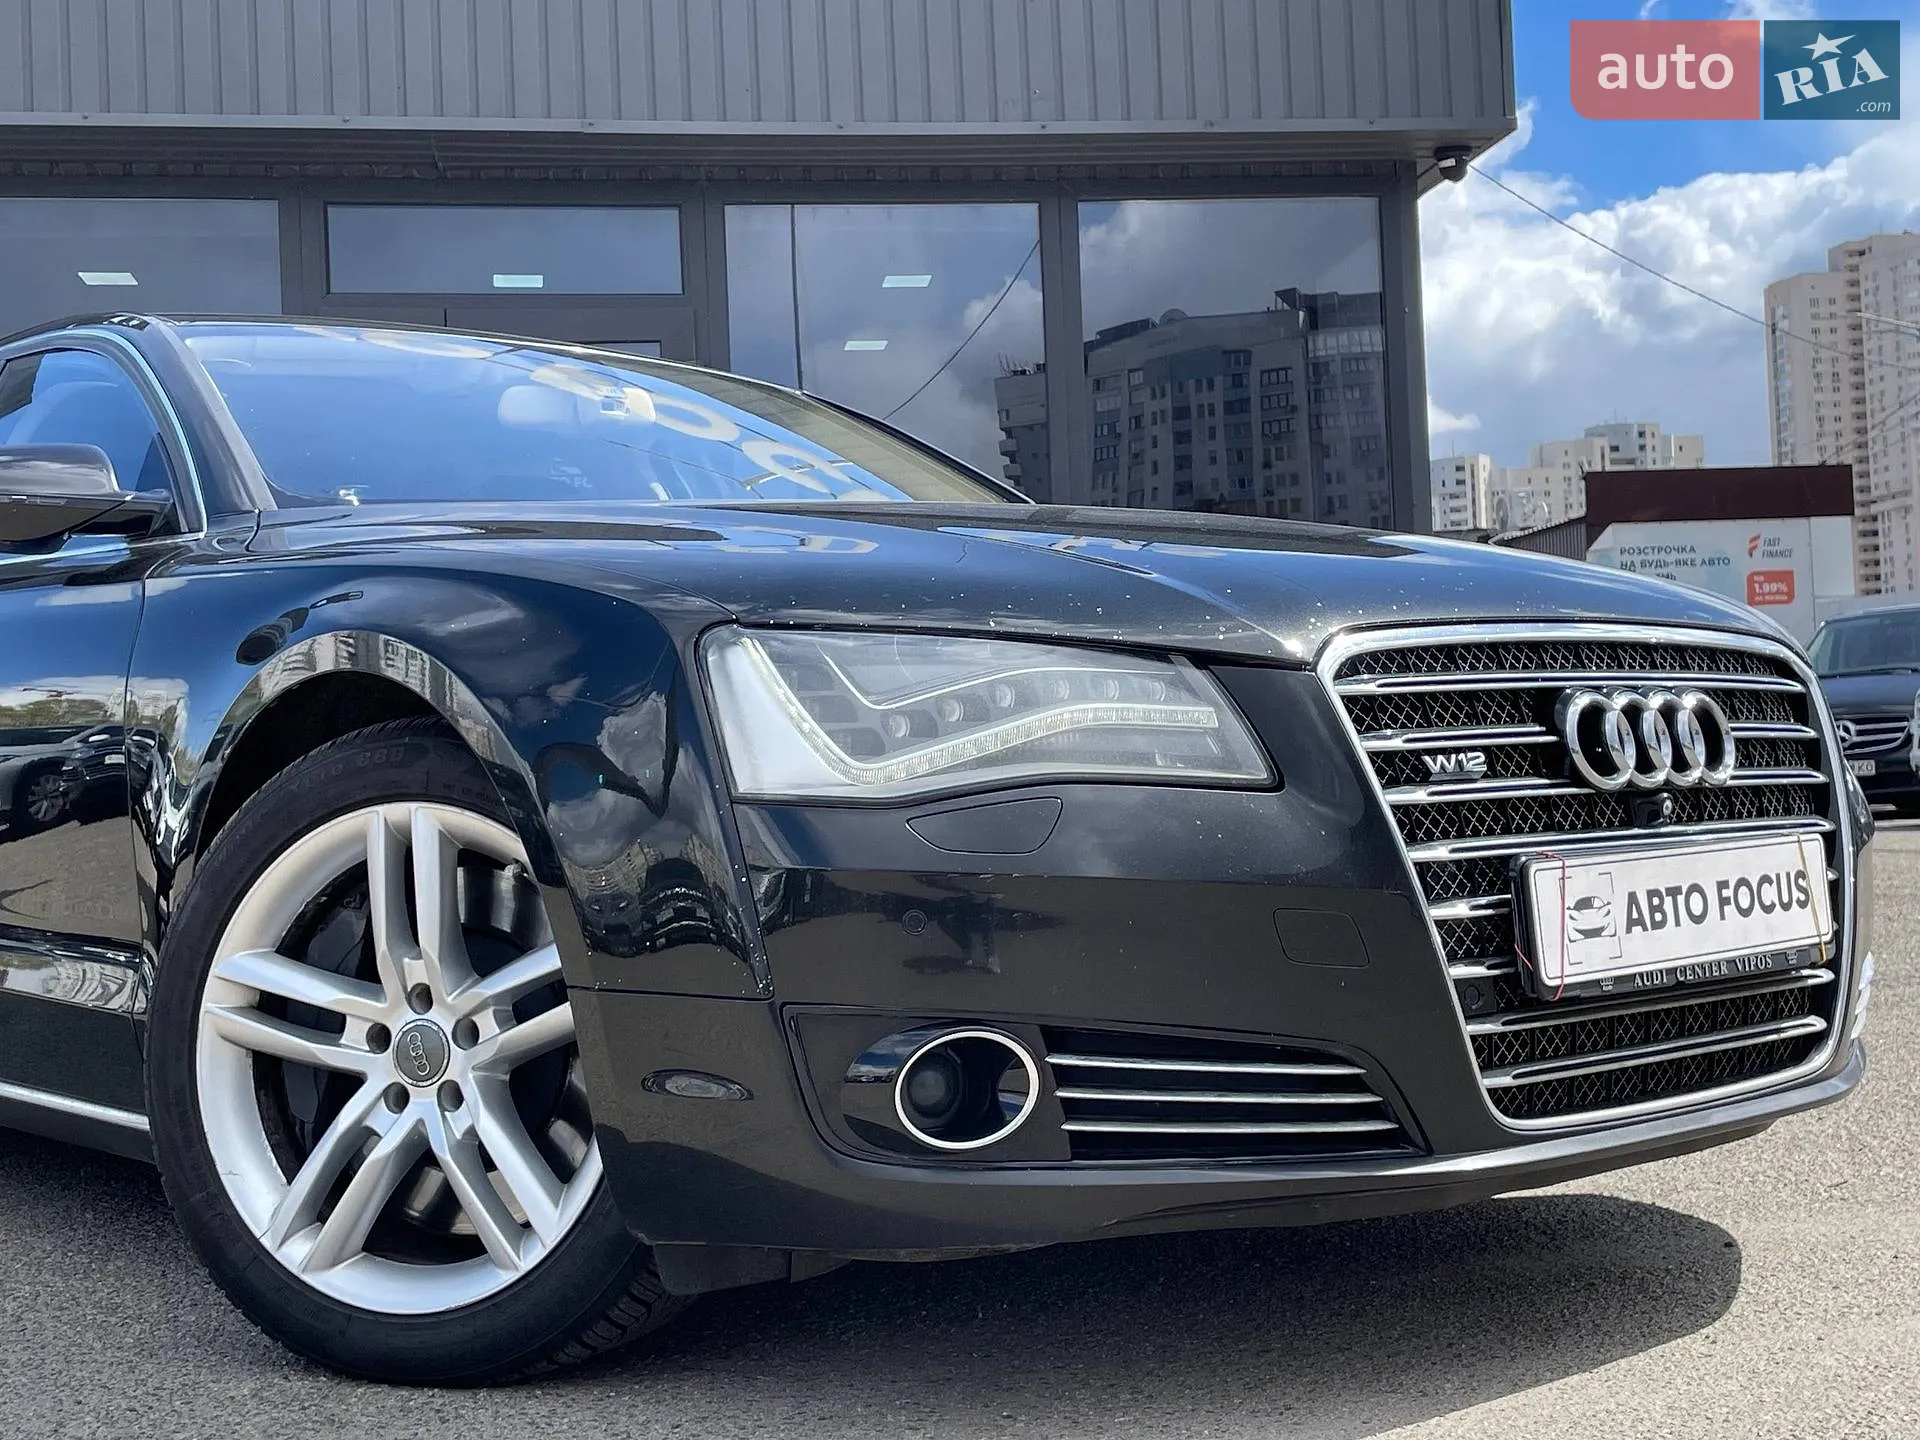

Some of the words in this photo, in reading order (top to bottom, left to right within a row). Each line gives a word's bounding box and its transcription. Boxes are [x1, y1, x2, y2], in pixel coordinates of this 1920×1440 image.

[1619, 544, 1697, 556] РОЗСТРОЧКА
[1762, 547, 1793, 559] FINANCE
[1639, 557, 1697, 569] БУДЬ-ЯКЕ
[1699, 556, 1731, 568] АВТО
[1421, 751, 1488, 774] W12
[1625, 881, 1710, 935] АВТО
[1715, 868, 1812, 922] FOCUS
[1632, 970, 1668, 989] AUDI
[1676, 960, 1729, 983] CENTER
[1735, 953, 1774, 973] VIPOS
